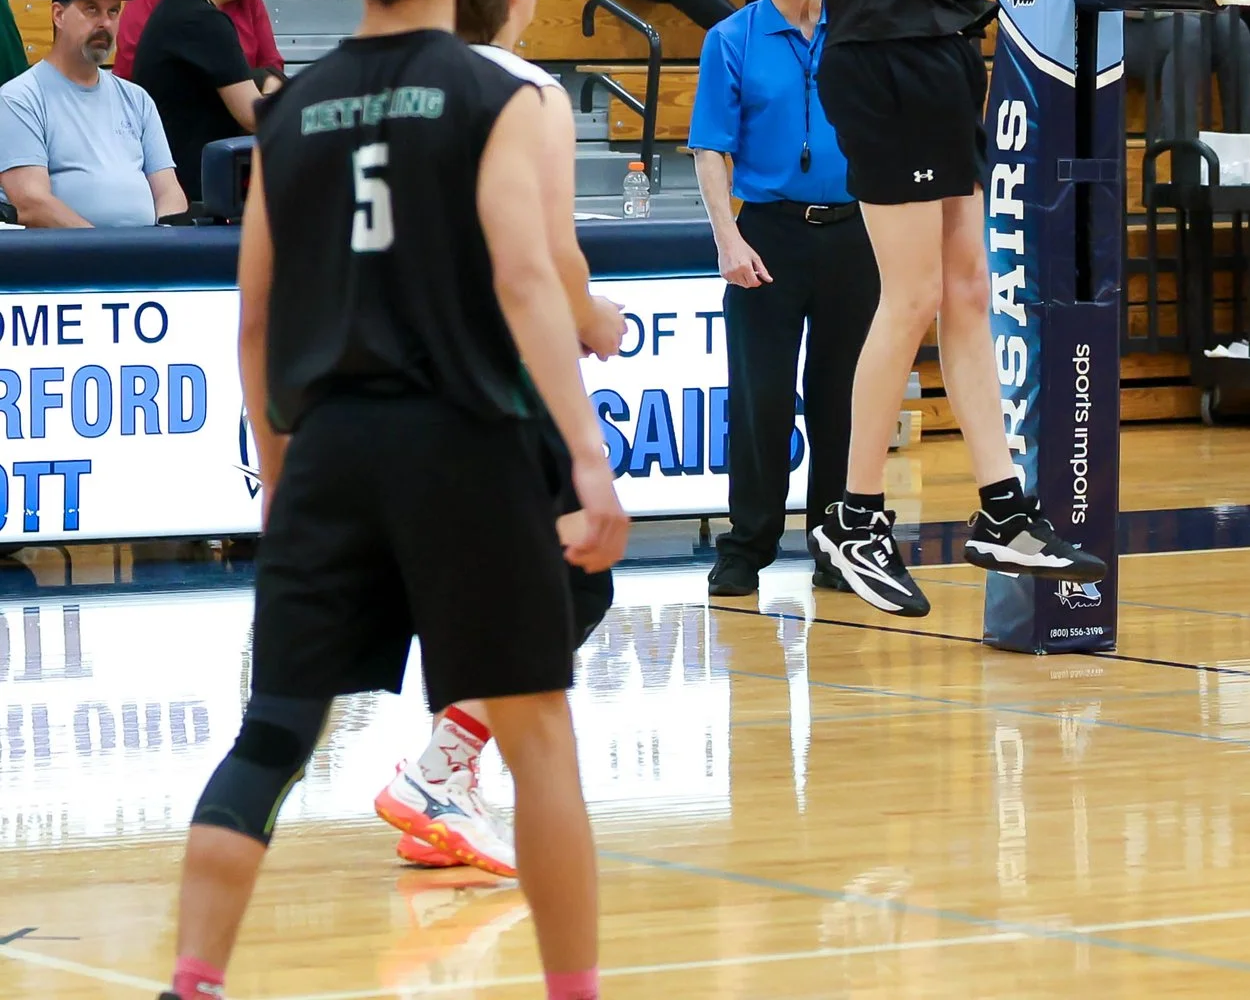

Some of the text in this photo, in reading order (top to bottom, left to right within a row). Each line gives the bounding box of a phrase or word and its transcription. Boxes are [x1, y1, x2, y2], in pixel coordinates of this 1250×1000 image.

[350, 142, 395, 253] 5
[623, 201, 634, 215] G
[0, 301, 169, 346] ME TO
[987, 99, 1028, 500] RSAIRS
[619, 312, 678, 357] OF
[1069, 343, 1091, 525] sports imports
[0, 459, 92, 533] TT
[1050, 626, 1104, 639] (800) 556-3198
